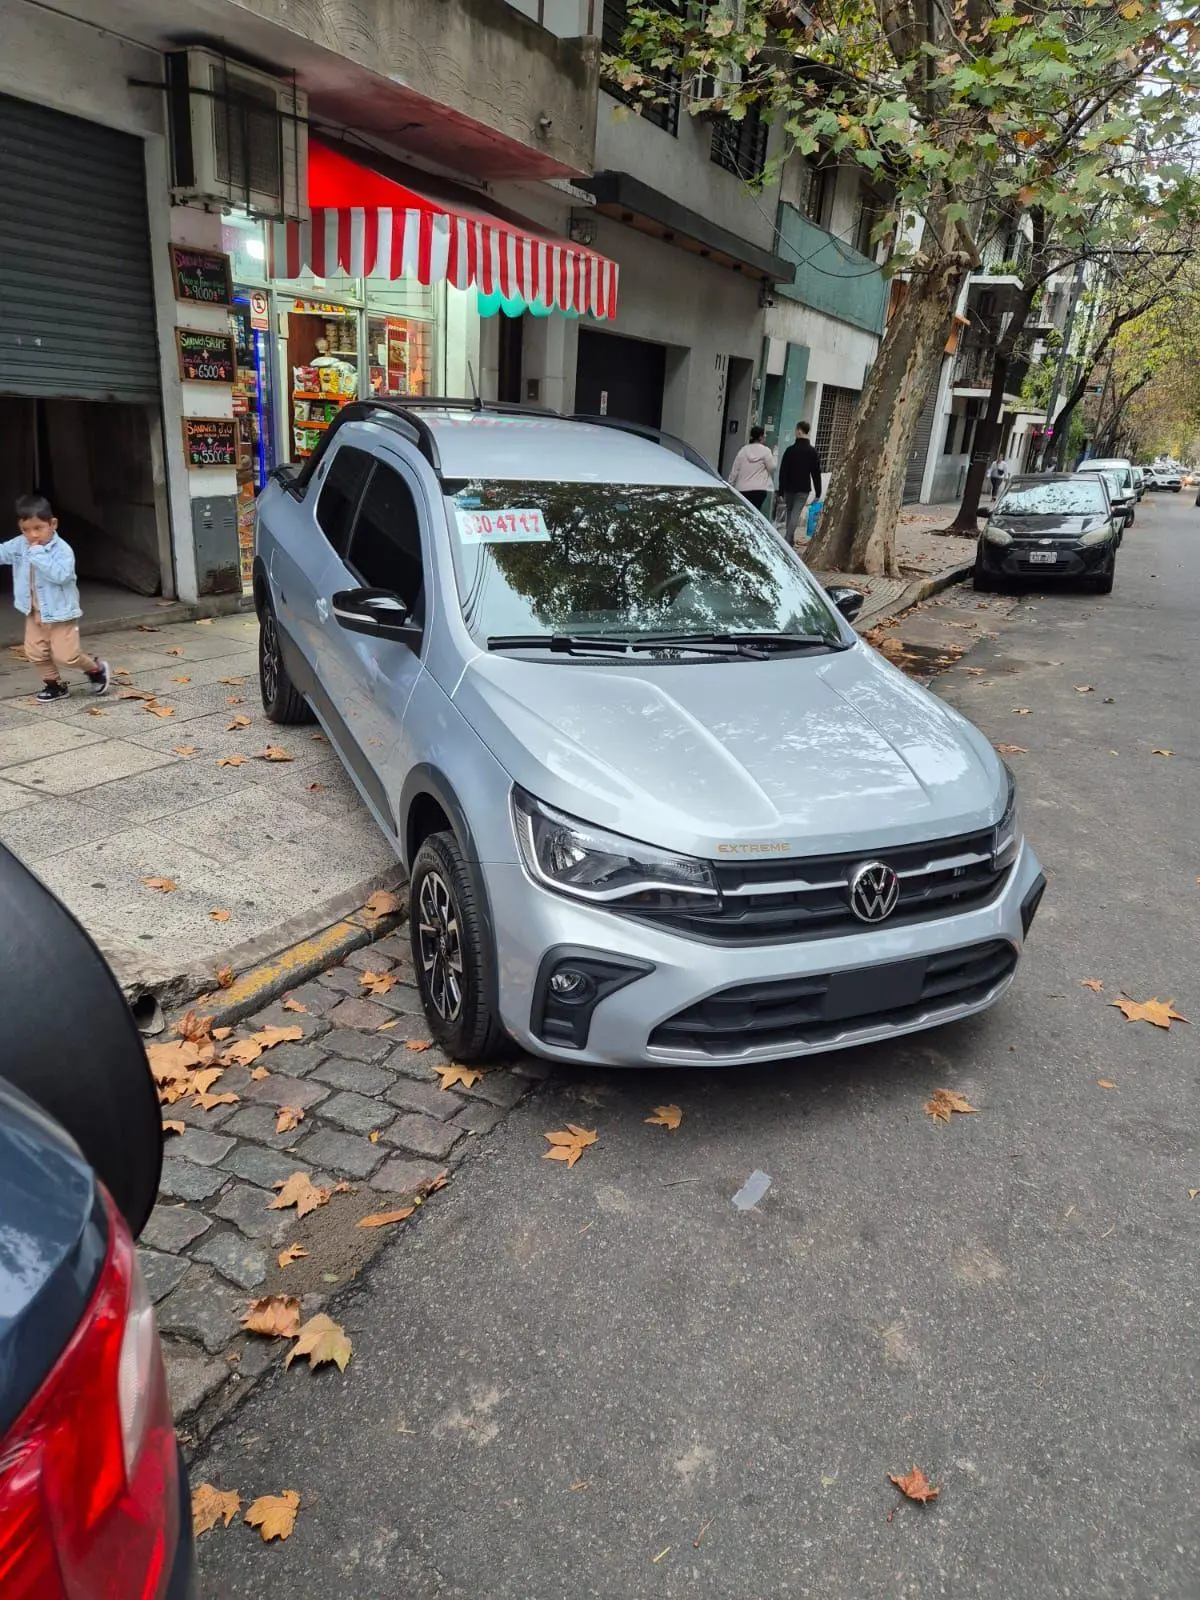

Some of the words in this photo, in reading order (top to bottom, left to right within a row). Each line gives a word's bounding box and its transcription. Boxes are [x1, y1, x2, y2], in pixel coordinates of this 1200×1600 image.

[198, 364, 219, 378] 6500
[202, 449, 224, 464] 5500
[717, 842, 791, 854] EXTREME
